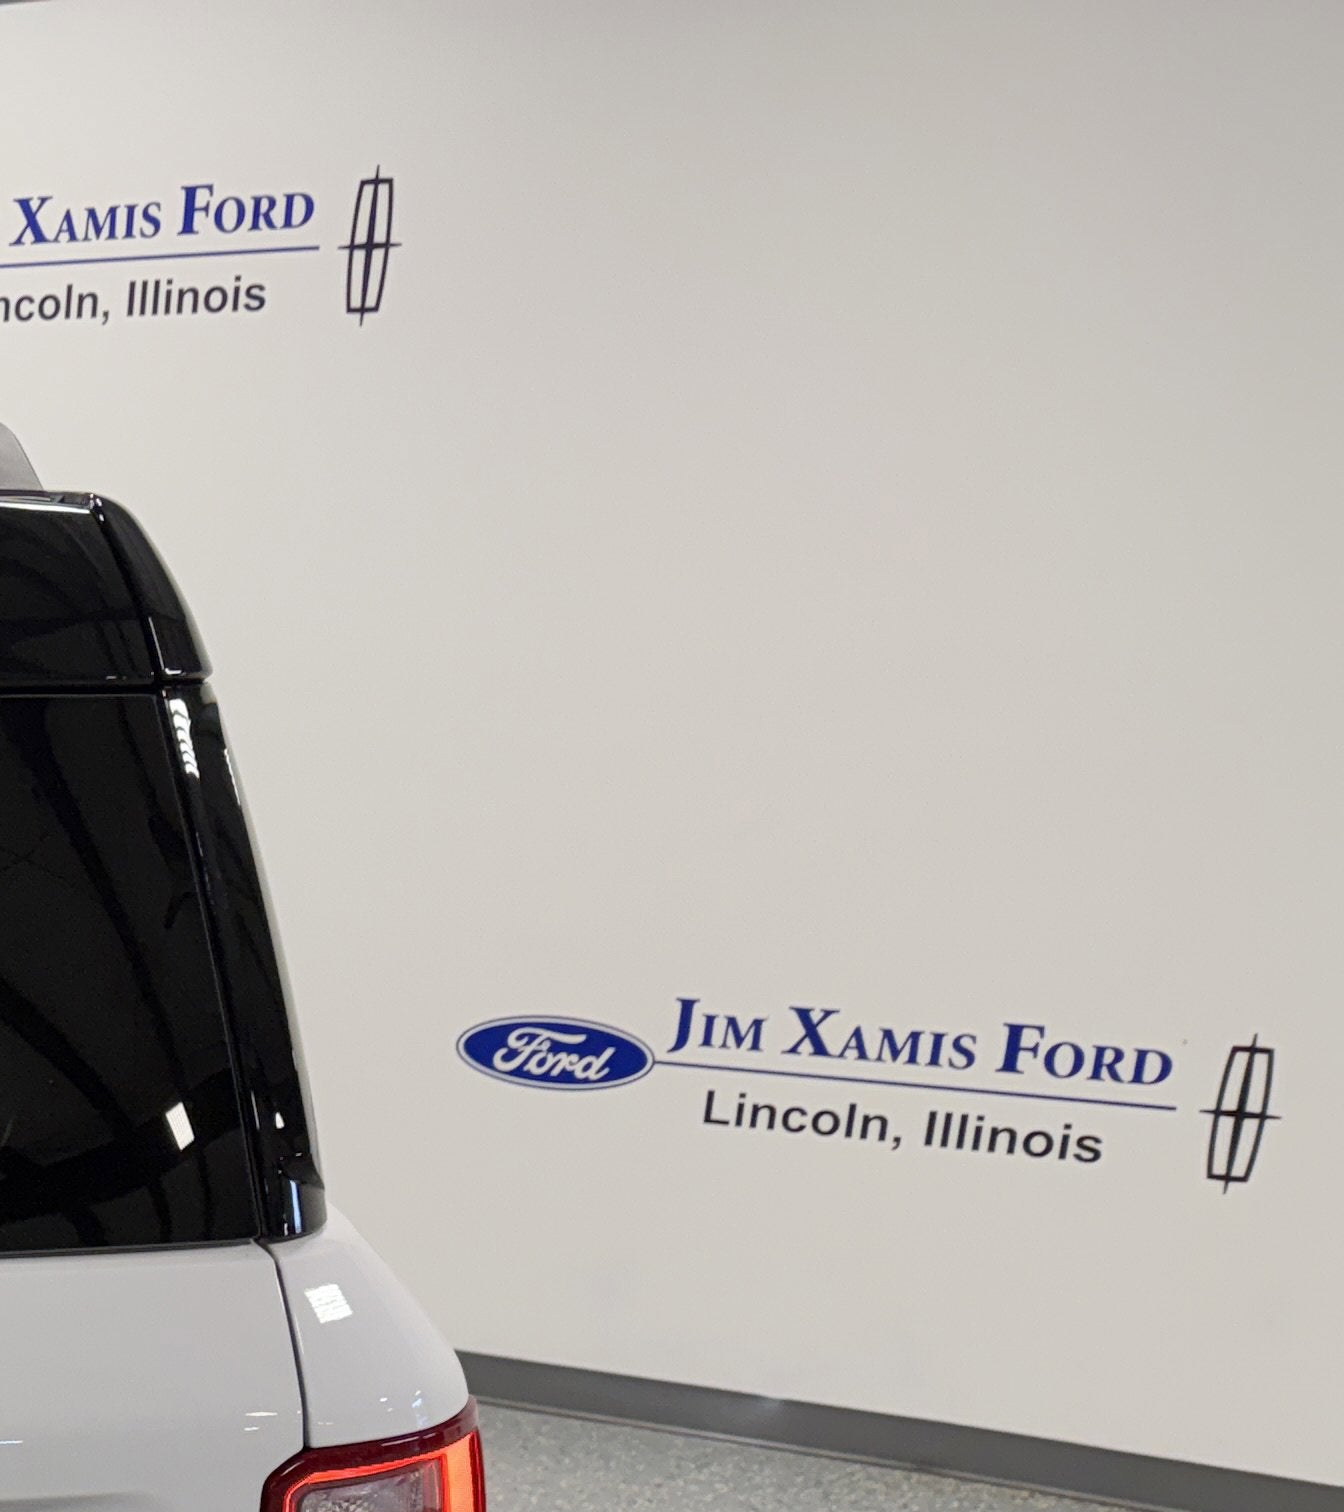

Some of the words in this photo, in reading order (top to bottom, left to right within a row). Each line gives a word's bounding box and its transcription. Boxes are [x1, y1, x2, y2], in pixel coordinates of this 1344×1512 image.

[9, 196, 162, 247] XAMIS
[176, 183, 316, 236] FORD
[125, 276, 267, 320] Illinois
[492, 1029, 611, 1081] Ford
[667, 997, 768, 1055] JIM
[784, 1007, 979, 1070] XAMIS
[995, 1022, 1174, 1088] FORD
[702, 1090, 903, 1151] Lincoln,
[922, 1109, 1104, 1165] Illinois
